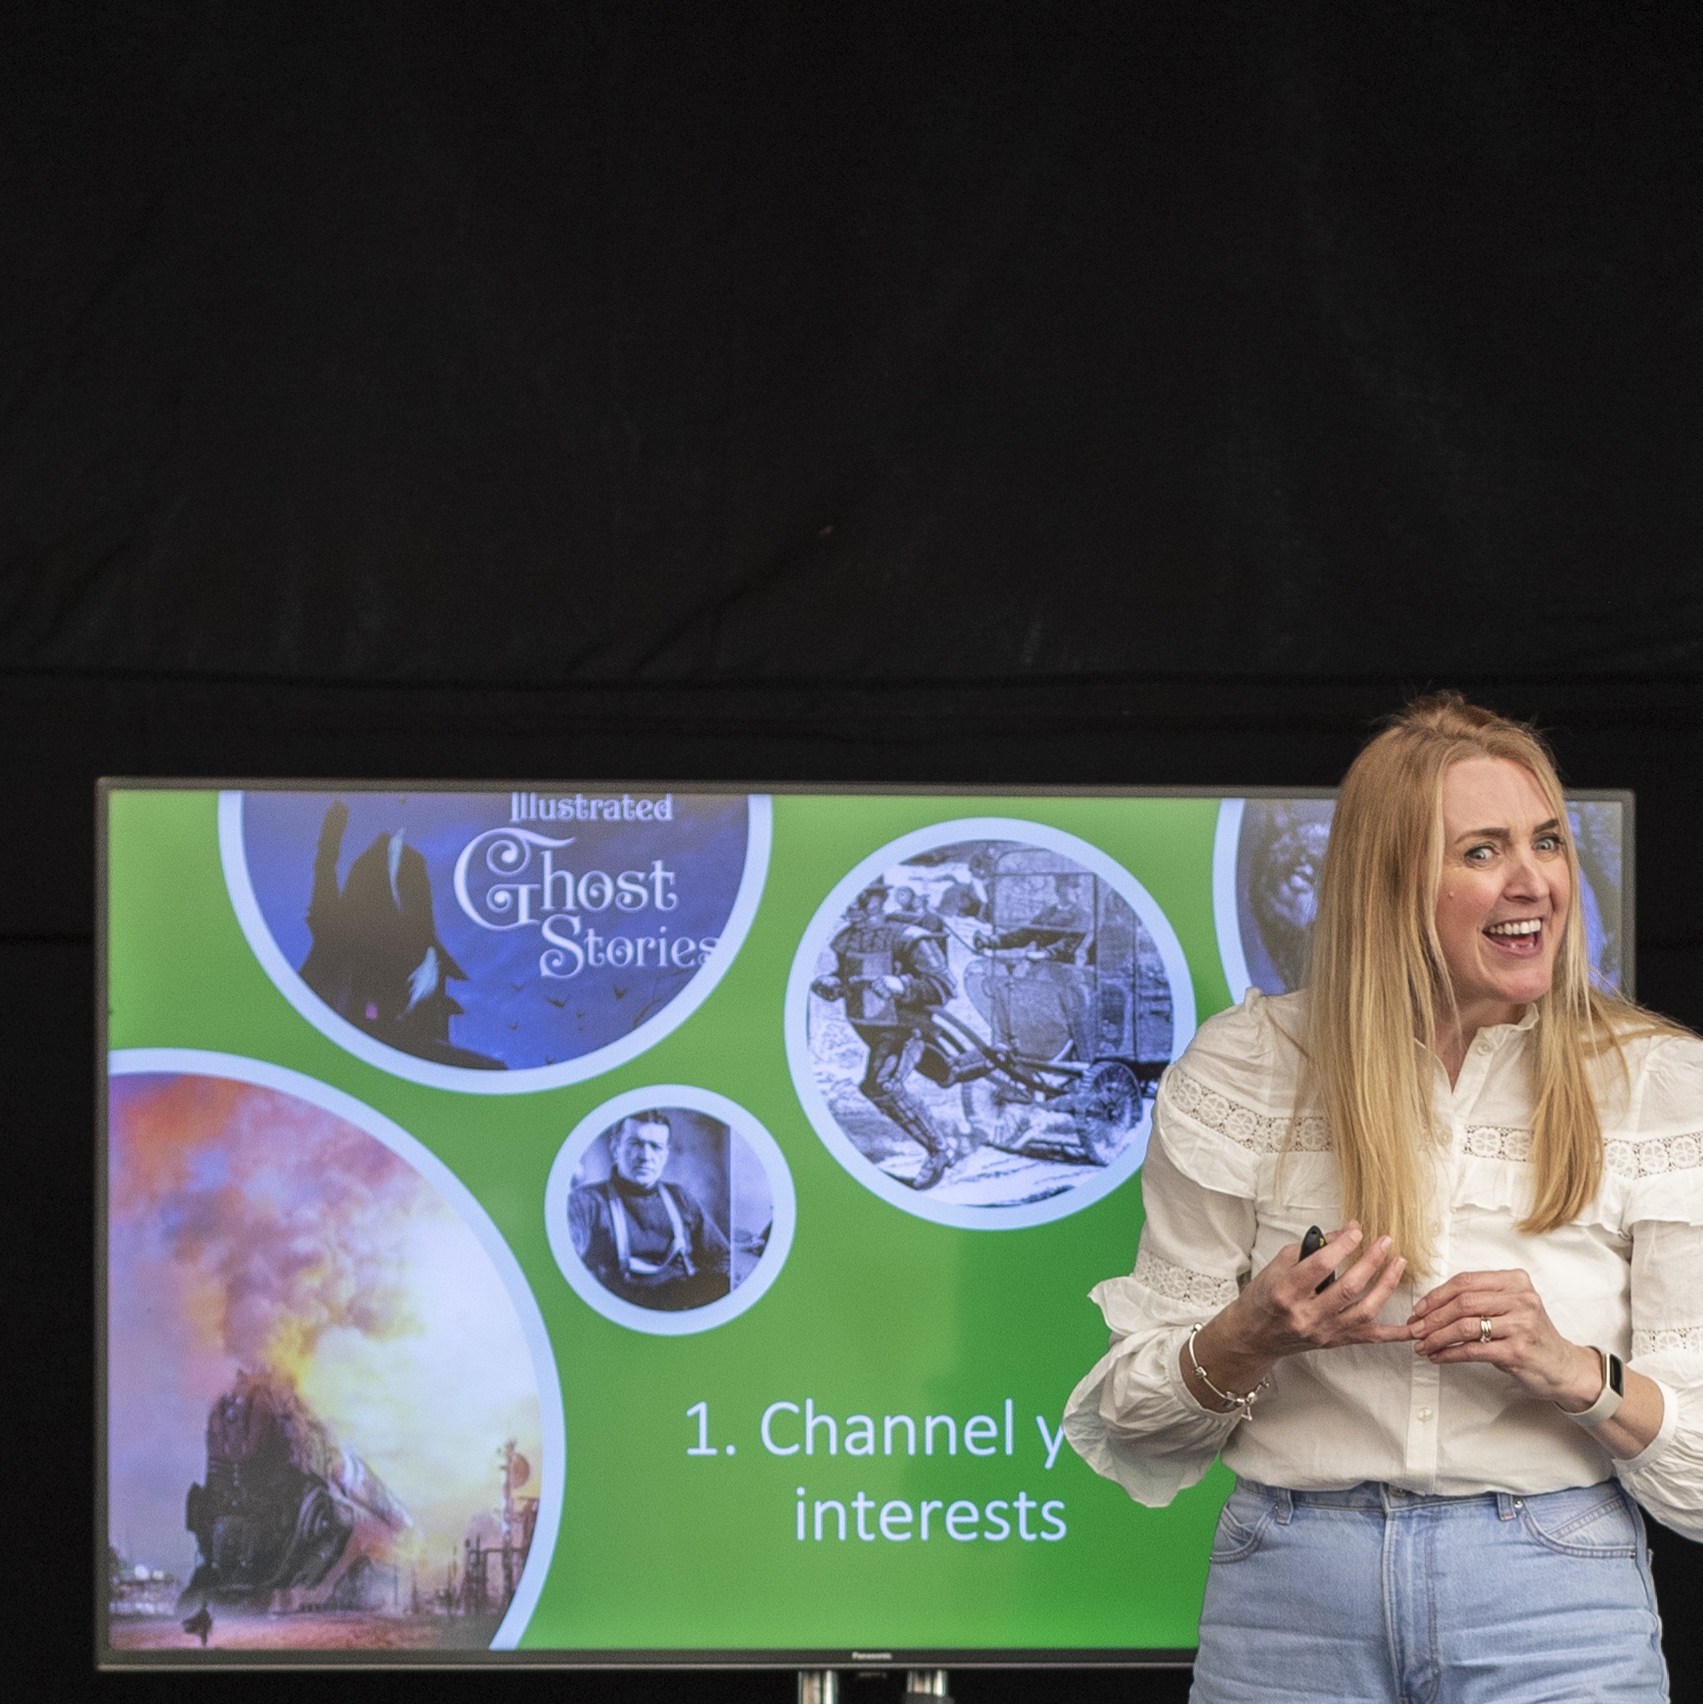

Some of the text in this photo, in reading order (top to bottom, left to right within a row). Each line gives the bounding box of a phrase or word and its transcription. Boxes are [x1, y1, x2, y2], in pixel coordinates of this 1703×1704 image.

[510, 792, 673, 821] Illustrated
[454, 827, 677, 930] Ghost
[539, 914, 721, 978] Stories
[686, 1402, 736, 1456] 1.
[760, 1398, 1013, 1456] Channel
[795, 1487, 1067, 1541] interests
